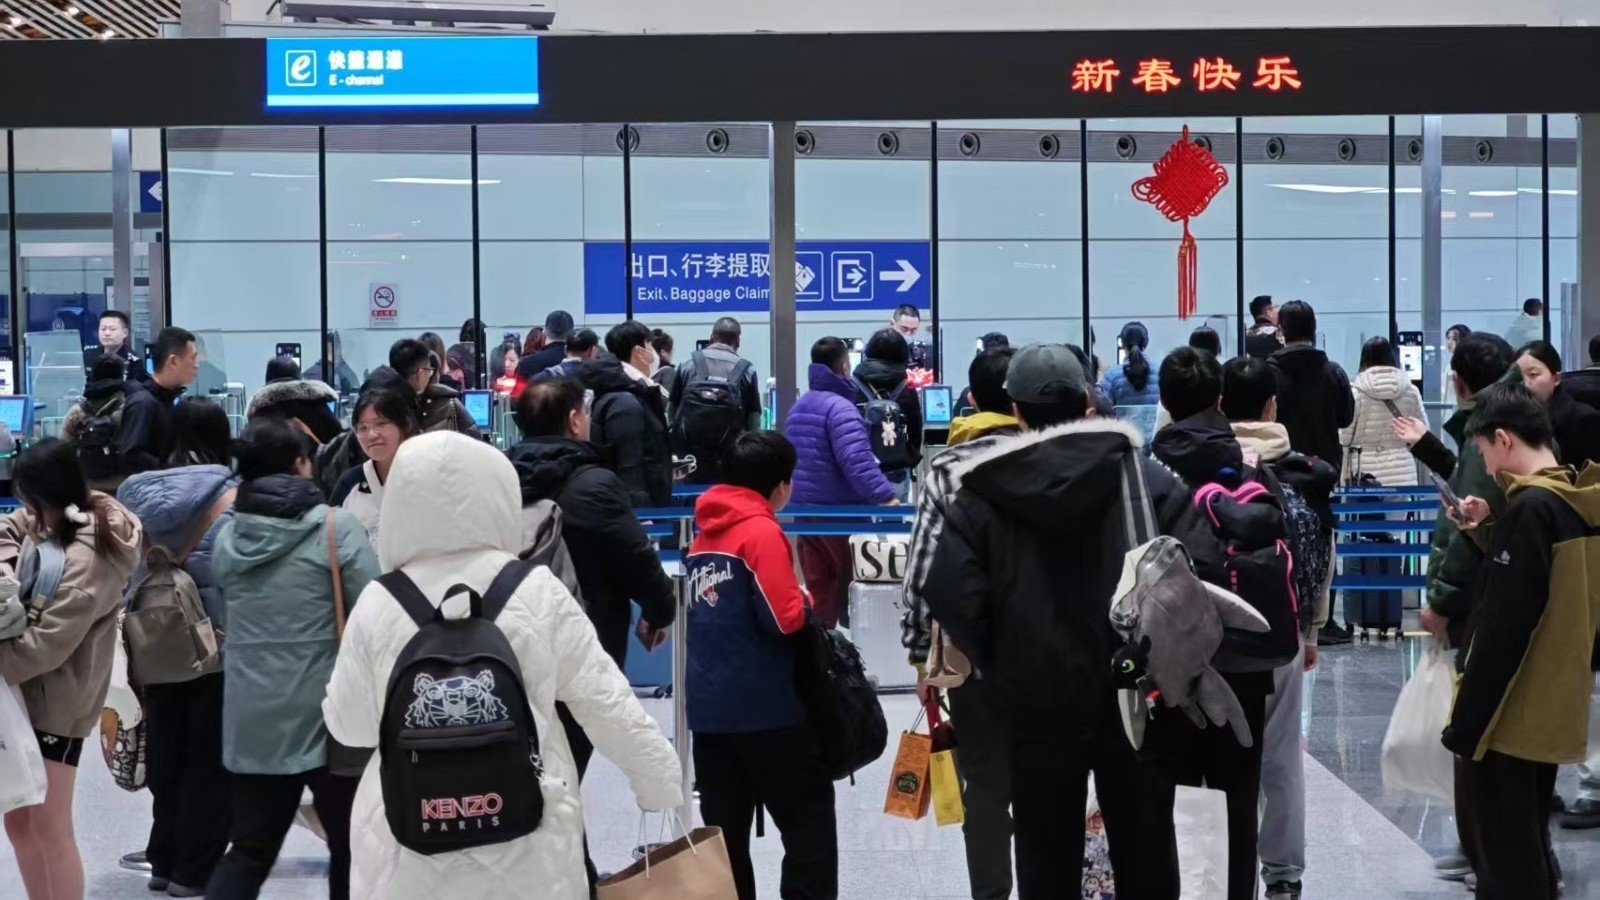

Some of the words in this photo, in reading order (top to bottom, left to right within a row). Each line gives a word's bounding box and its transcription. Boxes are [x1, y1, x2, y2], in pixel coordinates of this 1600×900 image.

[1071, 57, 1303, 93] 新春快乐
[421, 792, 503, 820] KENZO
[422, 816, 500, 833] PARIS
